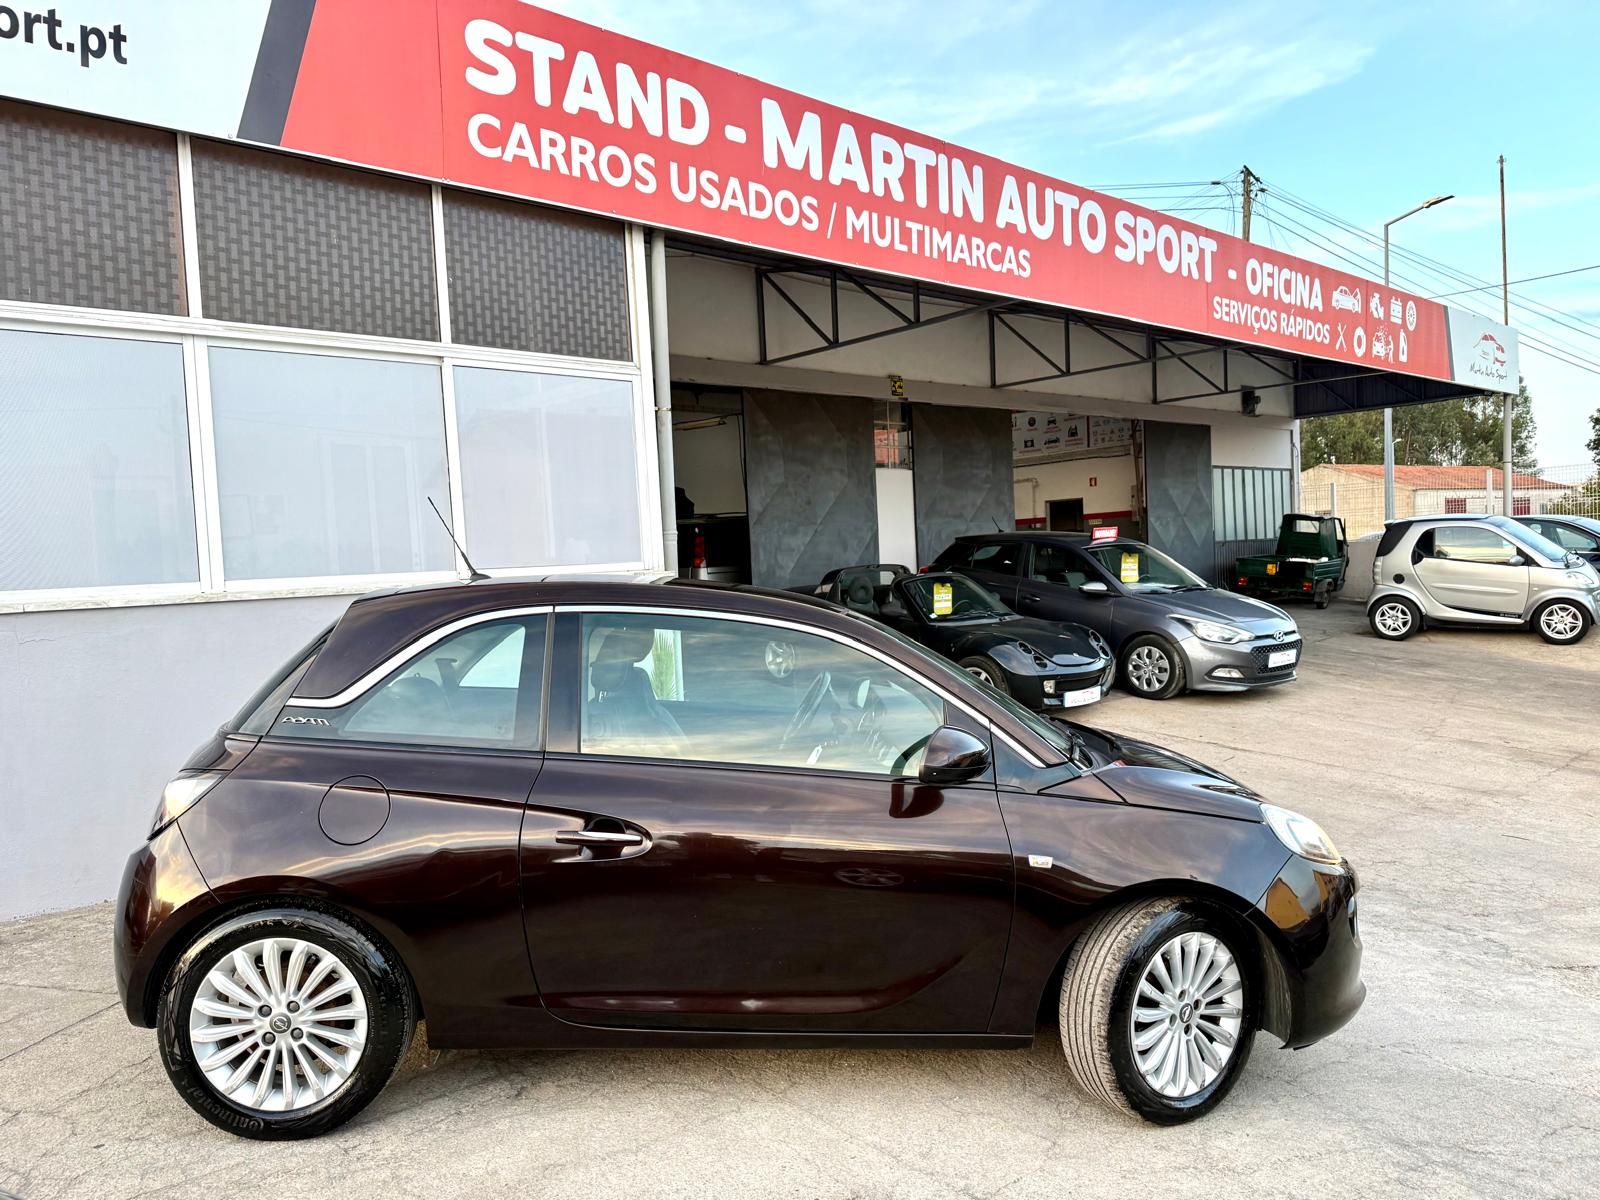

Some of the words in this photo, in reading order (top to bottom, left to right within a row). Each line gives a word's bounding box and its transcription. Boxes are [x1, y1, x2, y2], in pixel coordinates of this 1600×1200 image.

[0, 5, 128, 68] ort.pt
[465, 19, 710, 146] STAND
[725, 124, 747, 144] -
[762, 97, 985, 224] MARTIN
[996, 174, 1107, 254] AUTO
[1114, 210, 1218, 284] SPORT
[1227, 269, 1238, 281] -
[1245, 257, 1324, 313] OFICINA
[467, 113, 657, 195] CARROS
[669, 162, 820, 232] USADOS
[827, 202, 838, 239] /
[846, 206, 1032, 279] MULTIMARCAS
[1212, 295, 1278, 335] SERVIÇOS
[1280, 309, 1331, 344] RÁPIDOS
